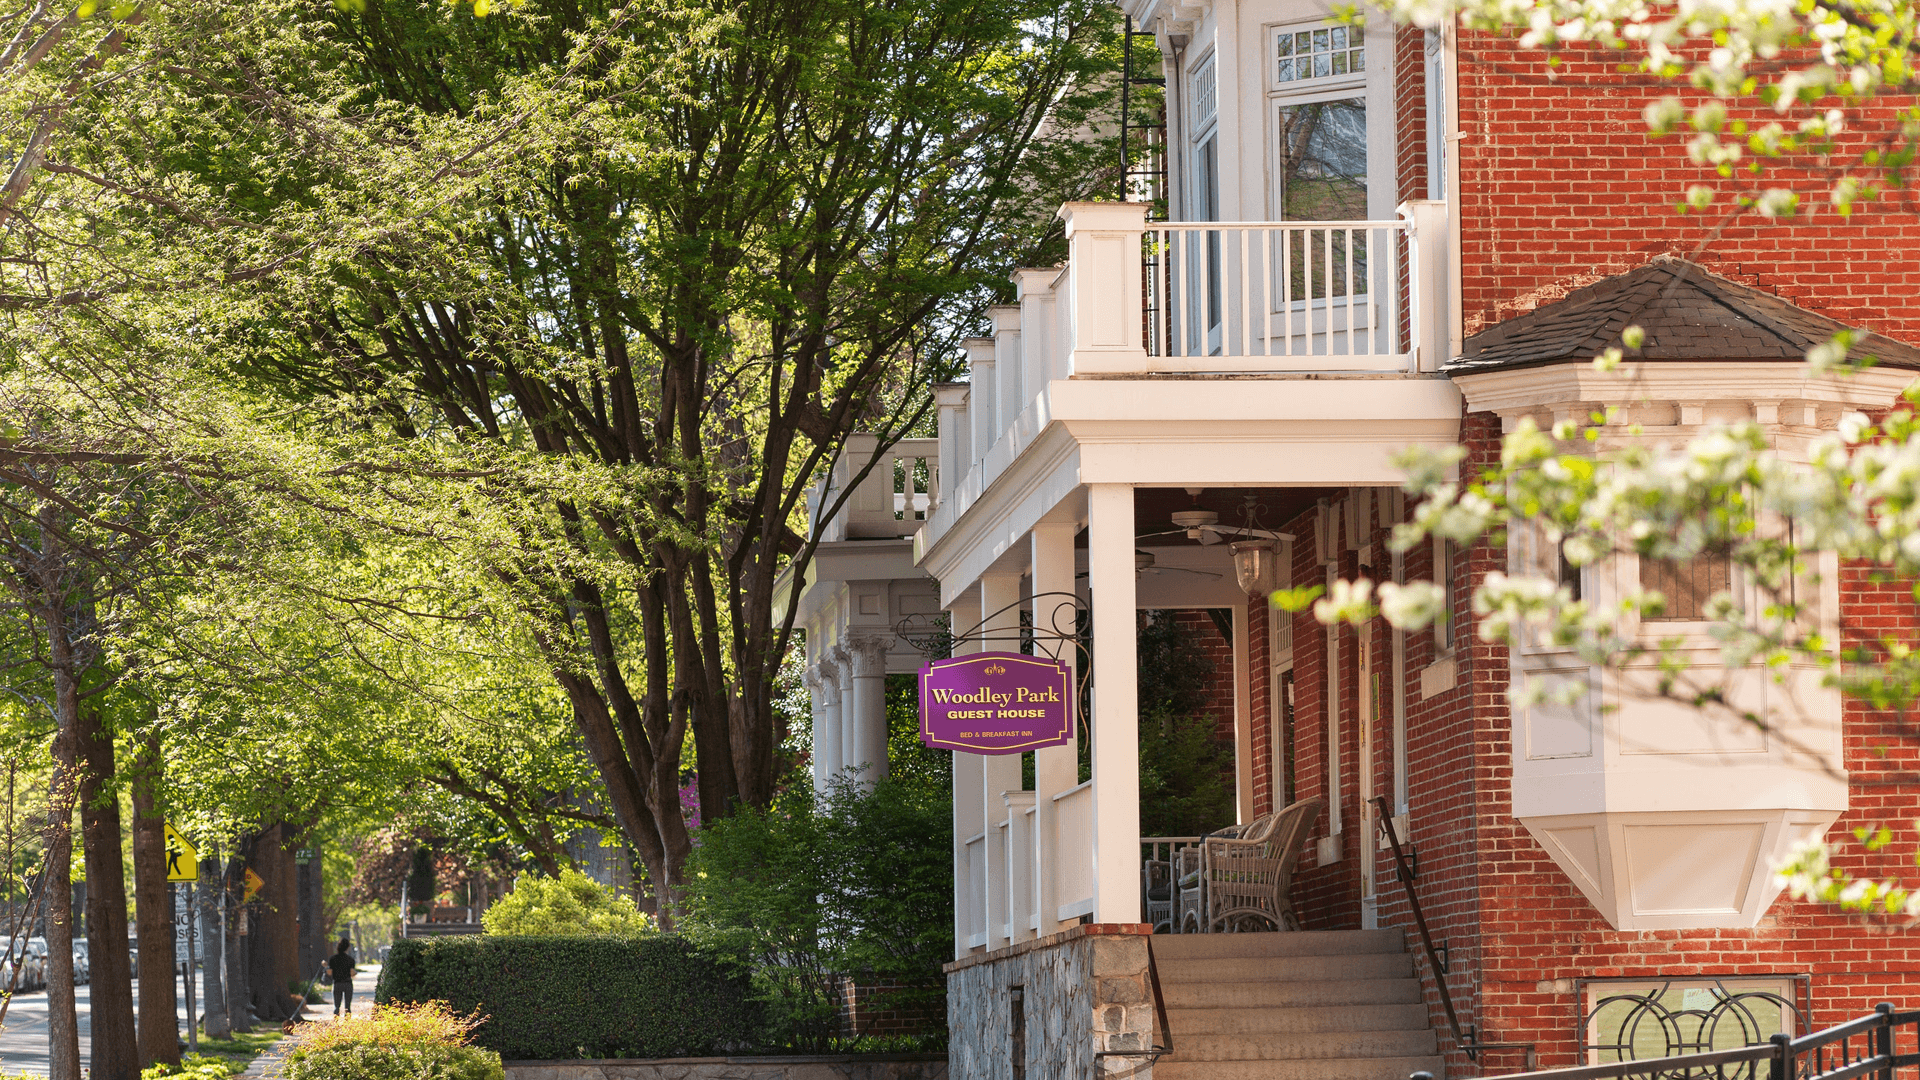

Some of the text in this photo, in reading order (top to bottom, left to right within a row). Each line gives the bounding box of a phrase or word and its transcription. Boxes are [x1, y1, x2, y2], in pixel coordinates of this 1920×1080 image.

[931, 686, 1060, 708] Woodley Park
[947, 709, 1046, 719] GUEST HOUSE
